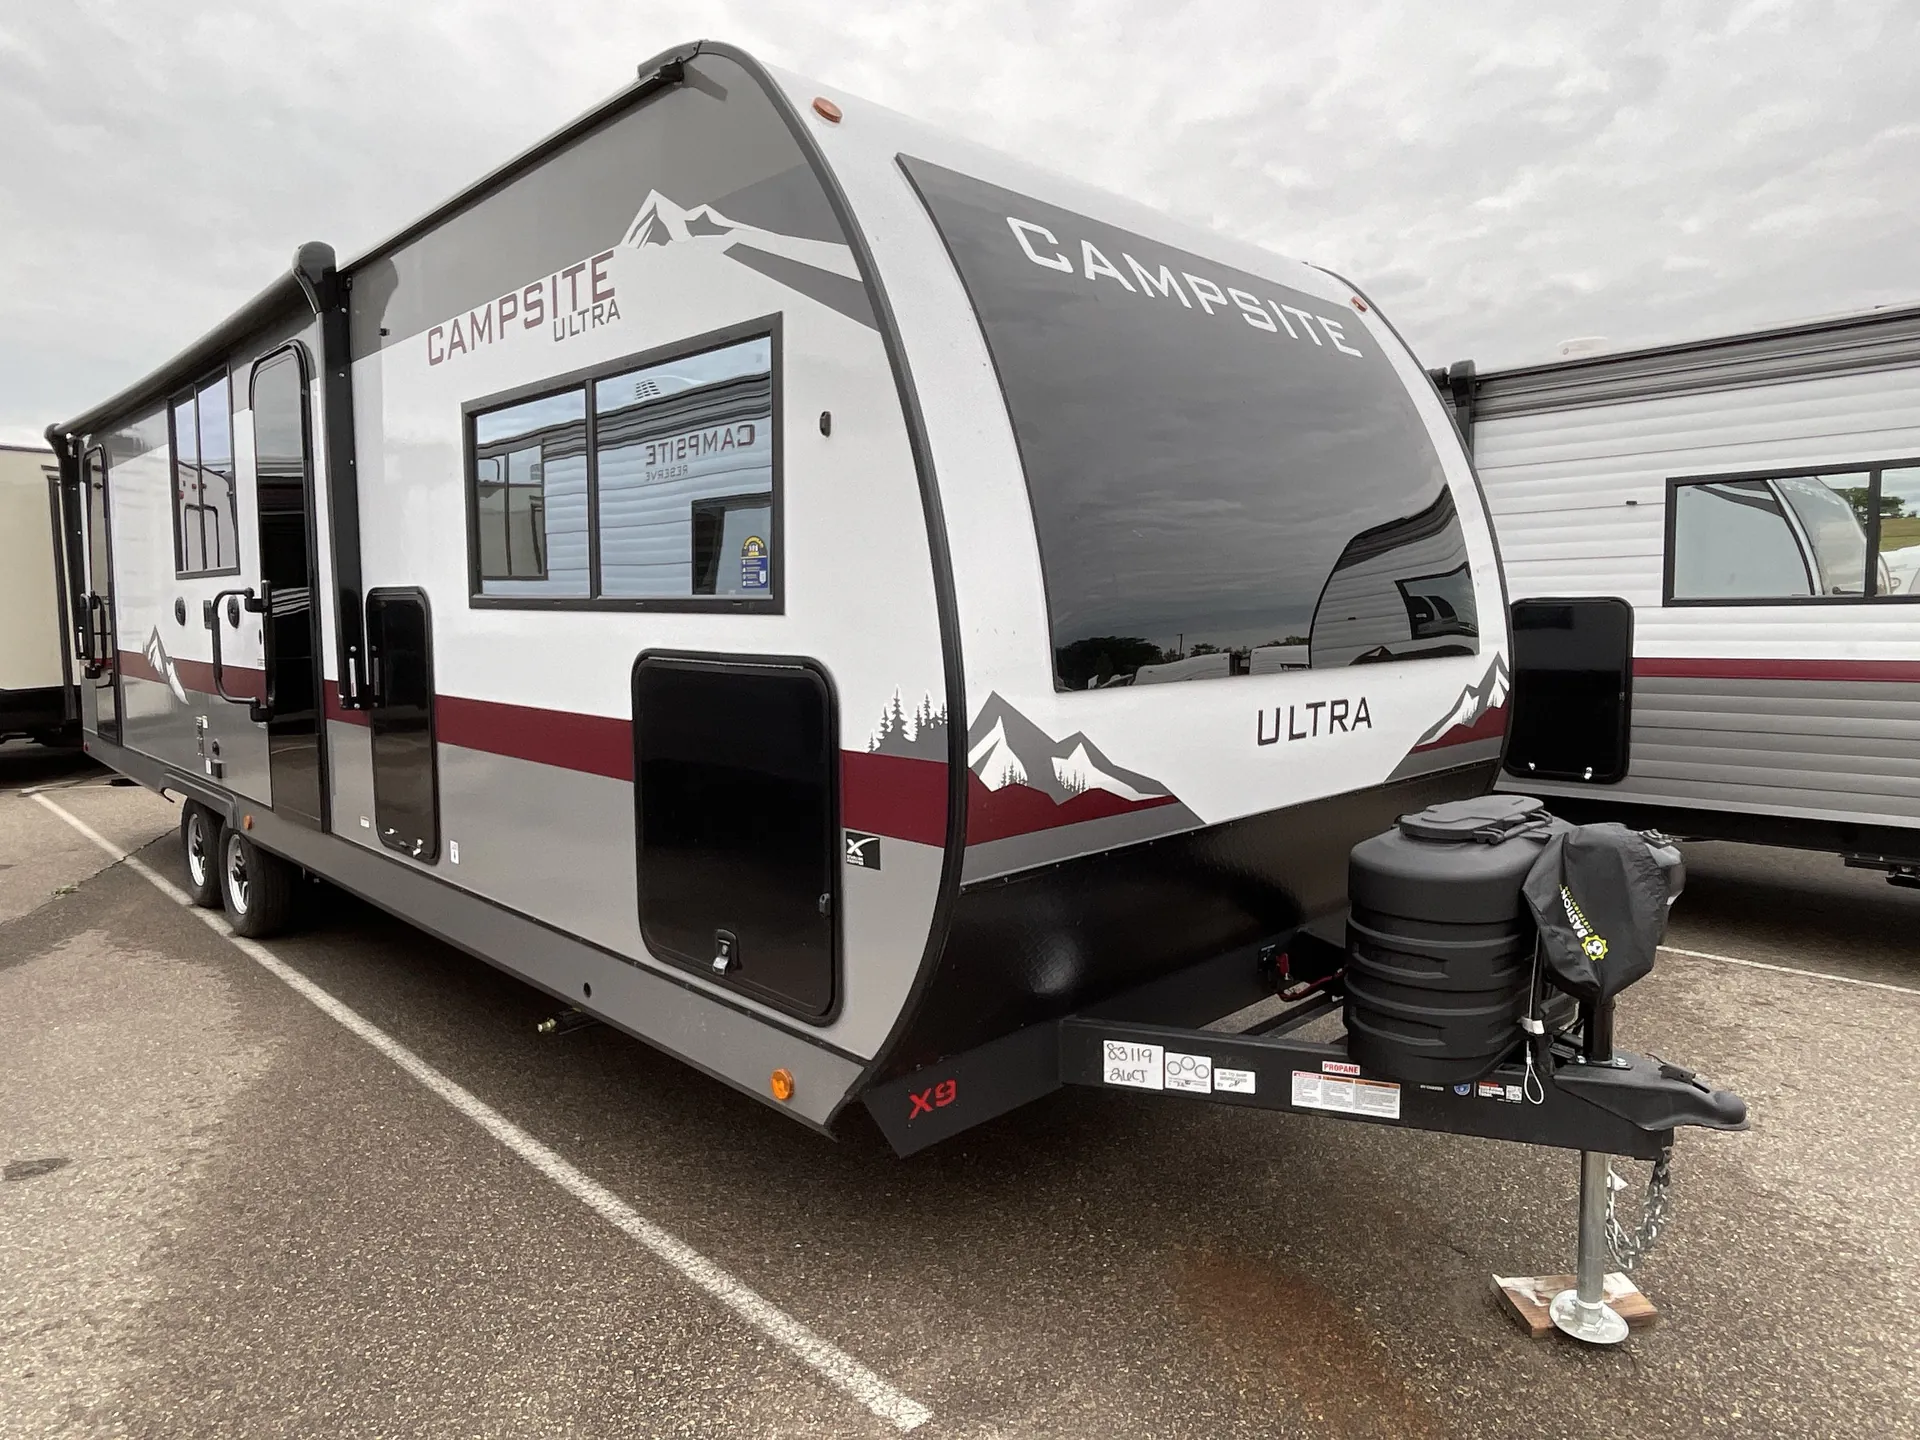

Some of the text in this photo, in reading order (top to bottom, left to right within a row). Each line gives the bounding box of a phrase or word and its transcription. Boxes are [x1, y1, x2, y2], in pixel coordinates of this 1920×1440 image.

[428, 250, 615, 366] CAMPSITE
[1006, 216, 1364, 359] CAMPSITE
[553, 299, 621, 343] ULTRA
[1257, 696, 1372, 746] ULTRA
[1561, 888, 1589, 938] BASTION
[1106, 1043, 1152, 1063] 83119
[1323, 1063, 1359, 1074] PROPANE
[909, 1079, 957, 1119] X9
